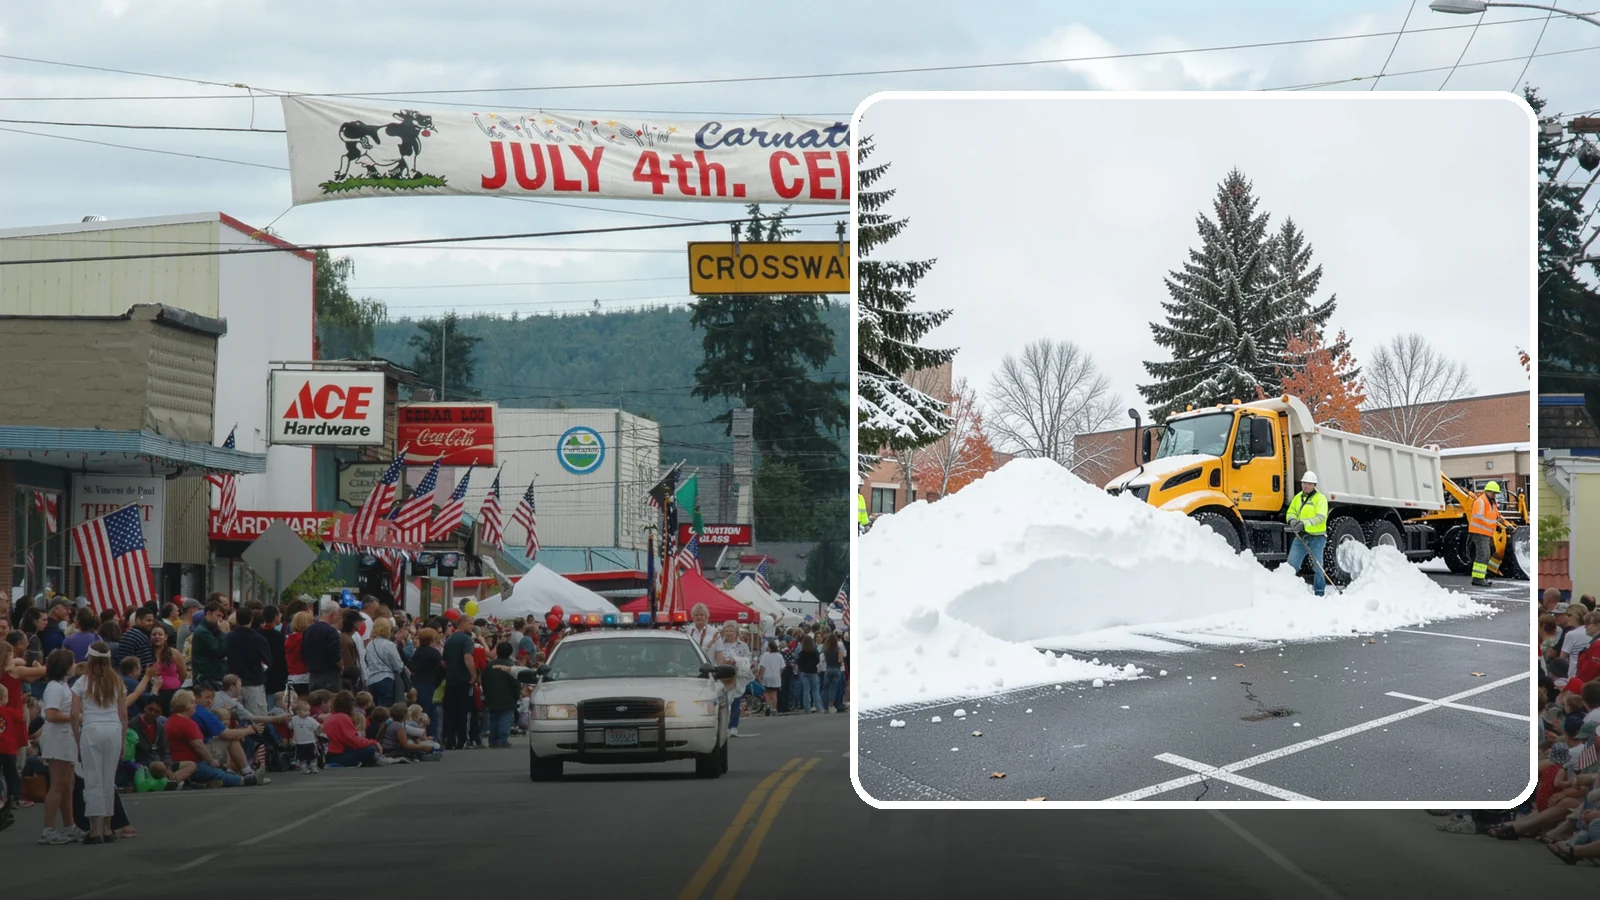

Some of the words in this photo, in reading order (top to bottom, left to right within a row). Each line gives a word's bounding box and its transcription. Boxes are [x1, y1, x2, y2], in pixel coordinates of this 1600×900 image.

[481, 141, 605, 192] JULY
[632, 150, 746, 197] 4th.
[697, 255, 850, 280] CROSSWA
[282, 380, 373, 420] ACE
[406, 410, 452, 422] CEDAR
[283, 421, 371, 436] Hardware
[416, 428, 477, 447] Coca-Cola
[83, 485, 93, 494] St.
[96, 485, 124, 494] Vincent
[126, 486, 136, 494] de
[138, 486, 155, 495] Paul
[688, 526, 741, 535] CRNATION
[699, 535, 730, 543] GLASS
